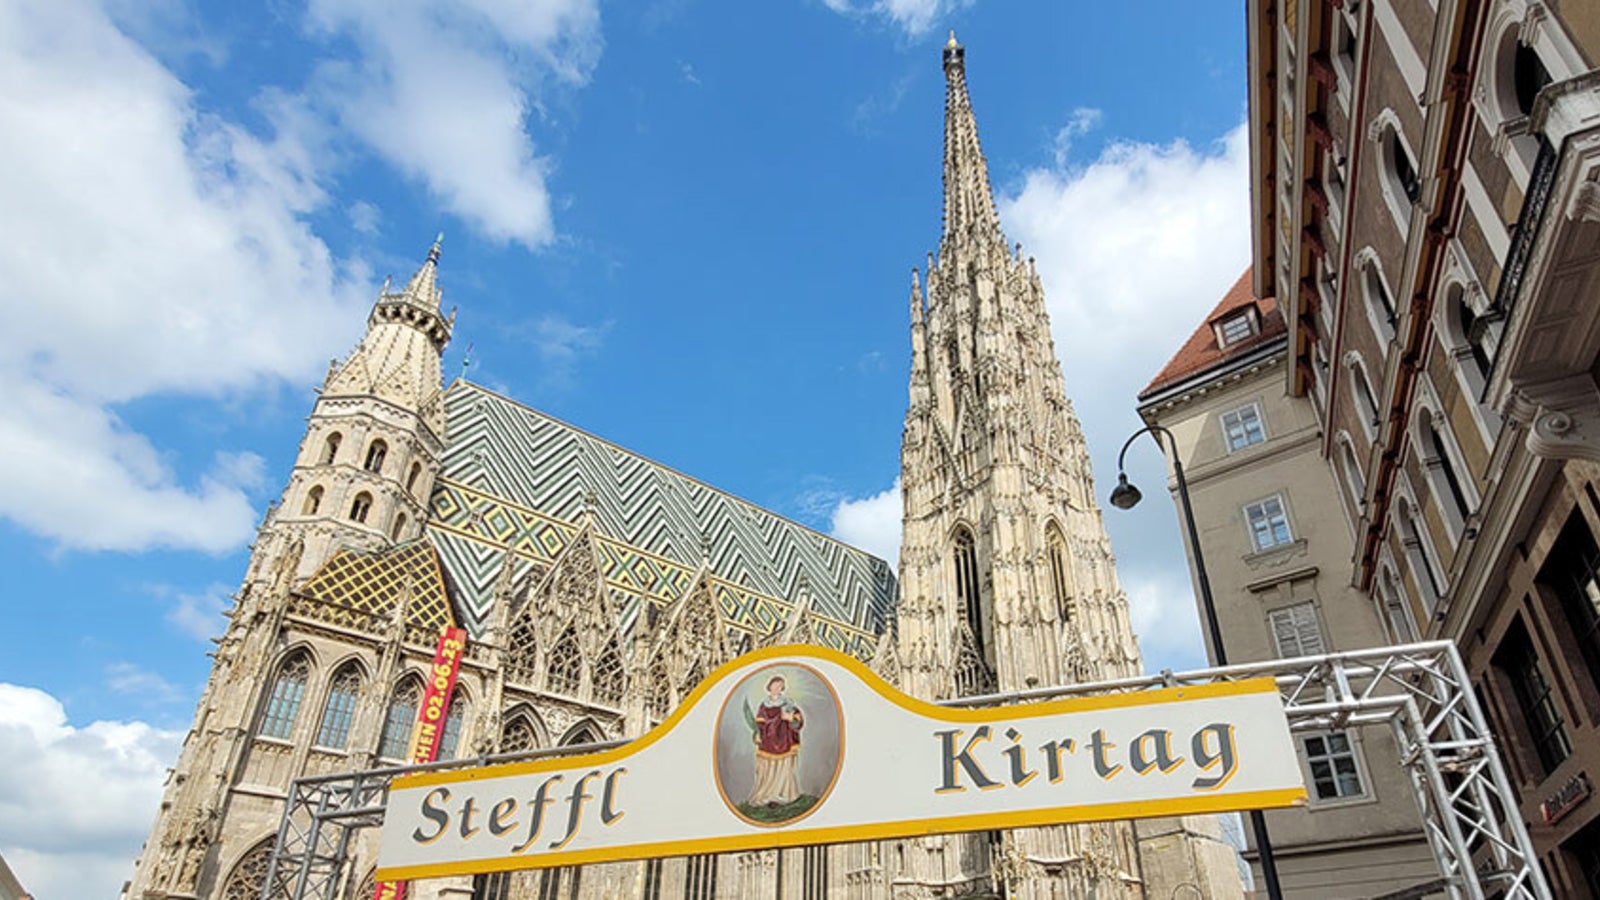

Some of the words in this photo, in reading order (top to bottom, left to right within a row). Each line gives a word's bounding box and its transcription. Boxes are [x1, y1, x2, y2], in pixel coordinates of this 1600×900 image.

[412, 722, 437, 770] CHEN
[425, 637, 463, 721] 02.06.23
[412, 767, 628, 855] Steffl
[933, 722, 1239, 793] Kirtag
